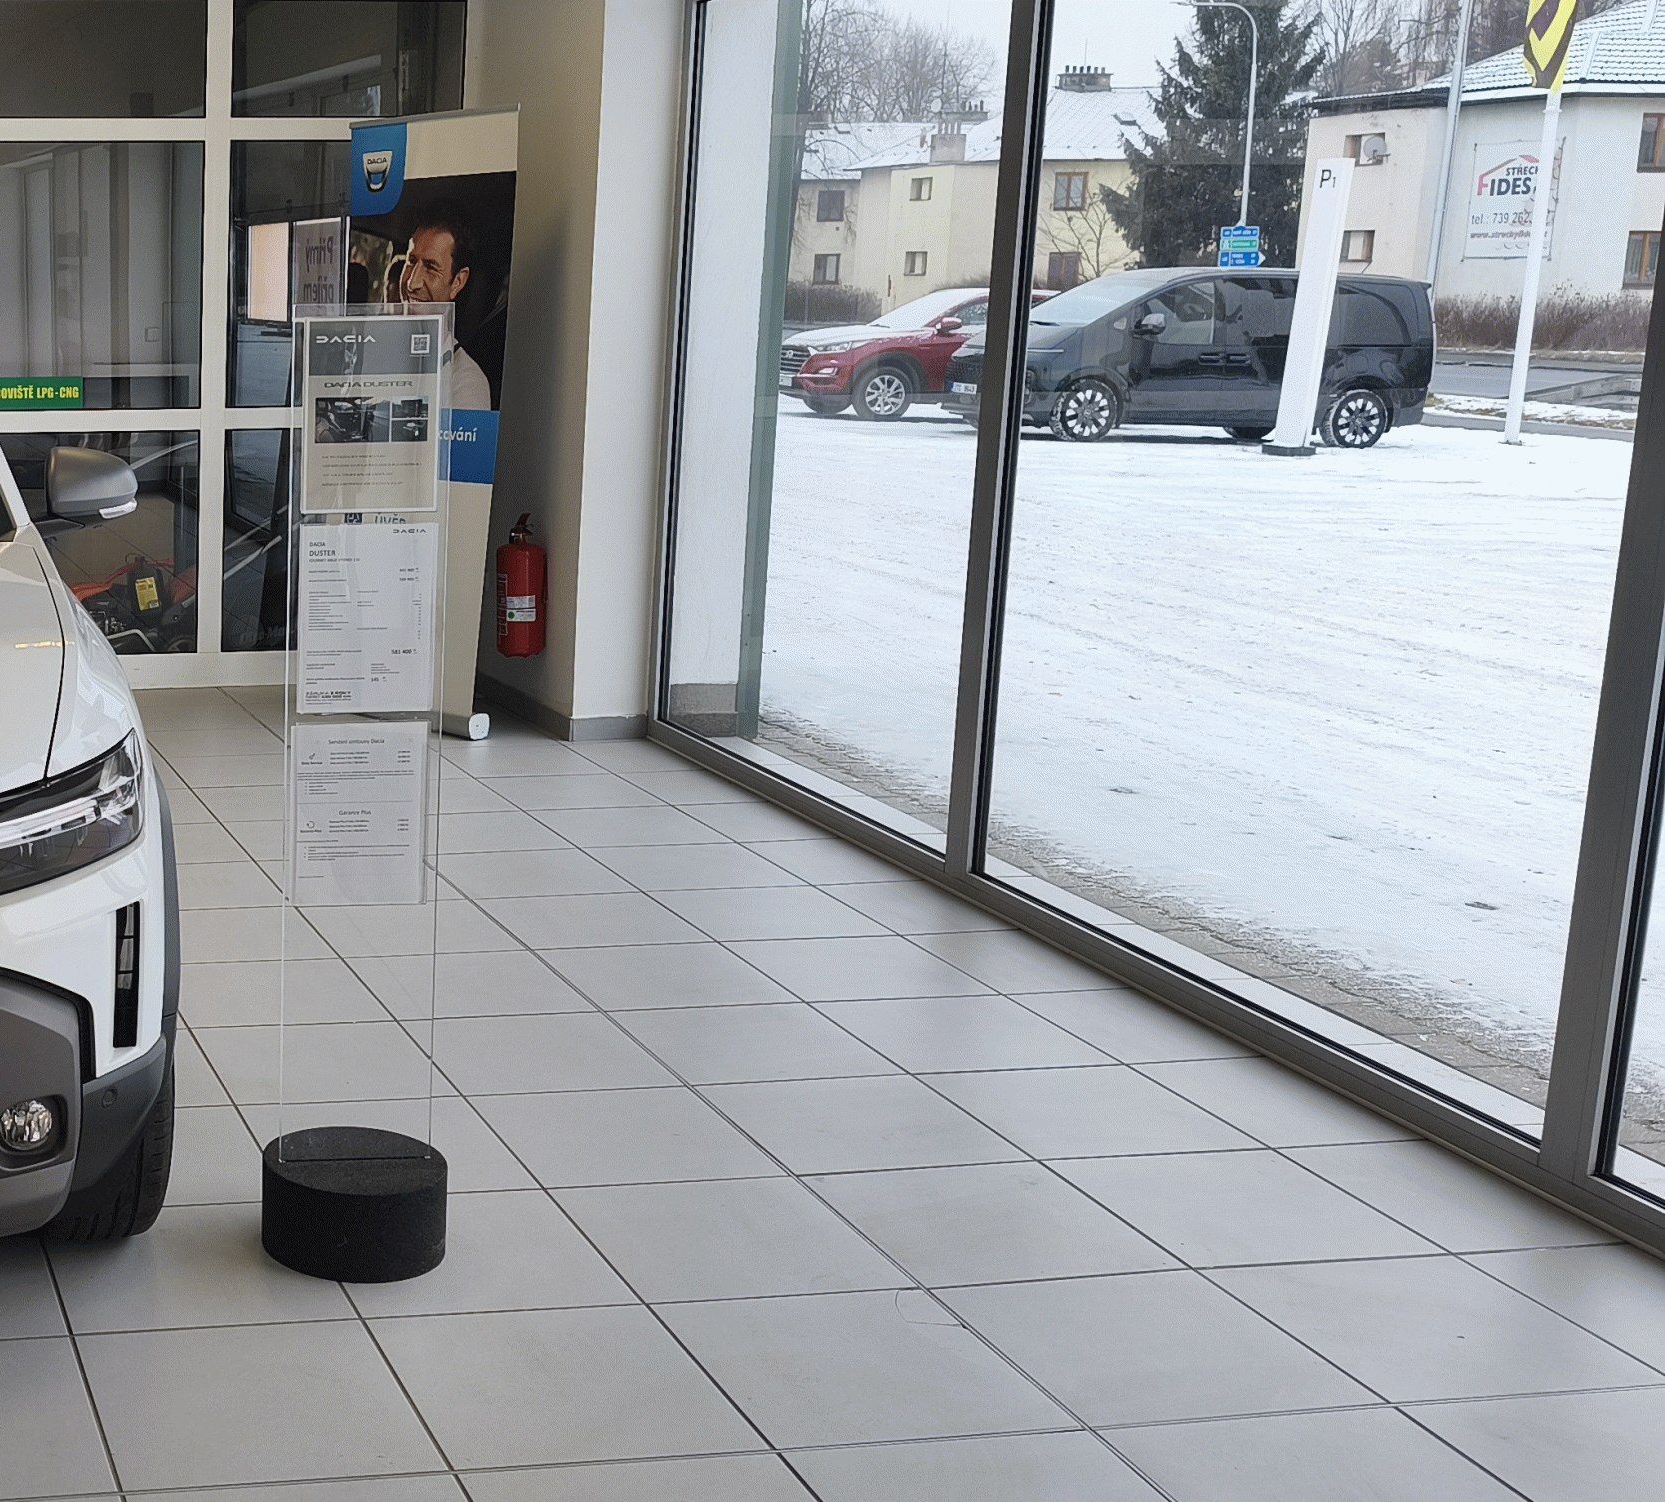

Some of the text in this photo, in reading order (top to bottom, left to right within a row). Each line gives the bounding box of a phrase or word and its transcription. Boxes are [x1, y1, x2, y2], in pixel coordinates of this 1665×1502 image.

[316, 334, 376, 343] DACIA
[438, 426, 477, 442] cování
[309, 549, 336, 557] DUSTER
